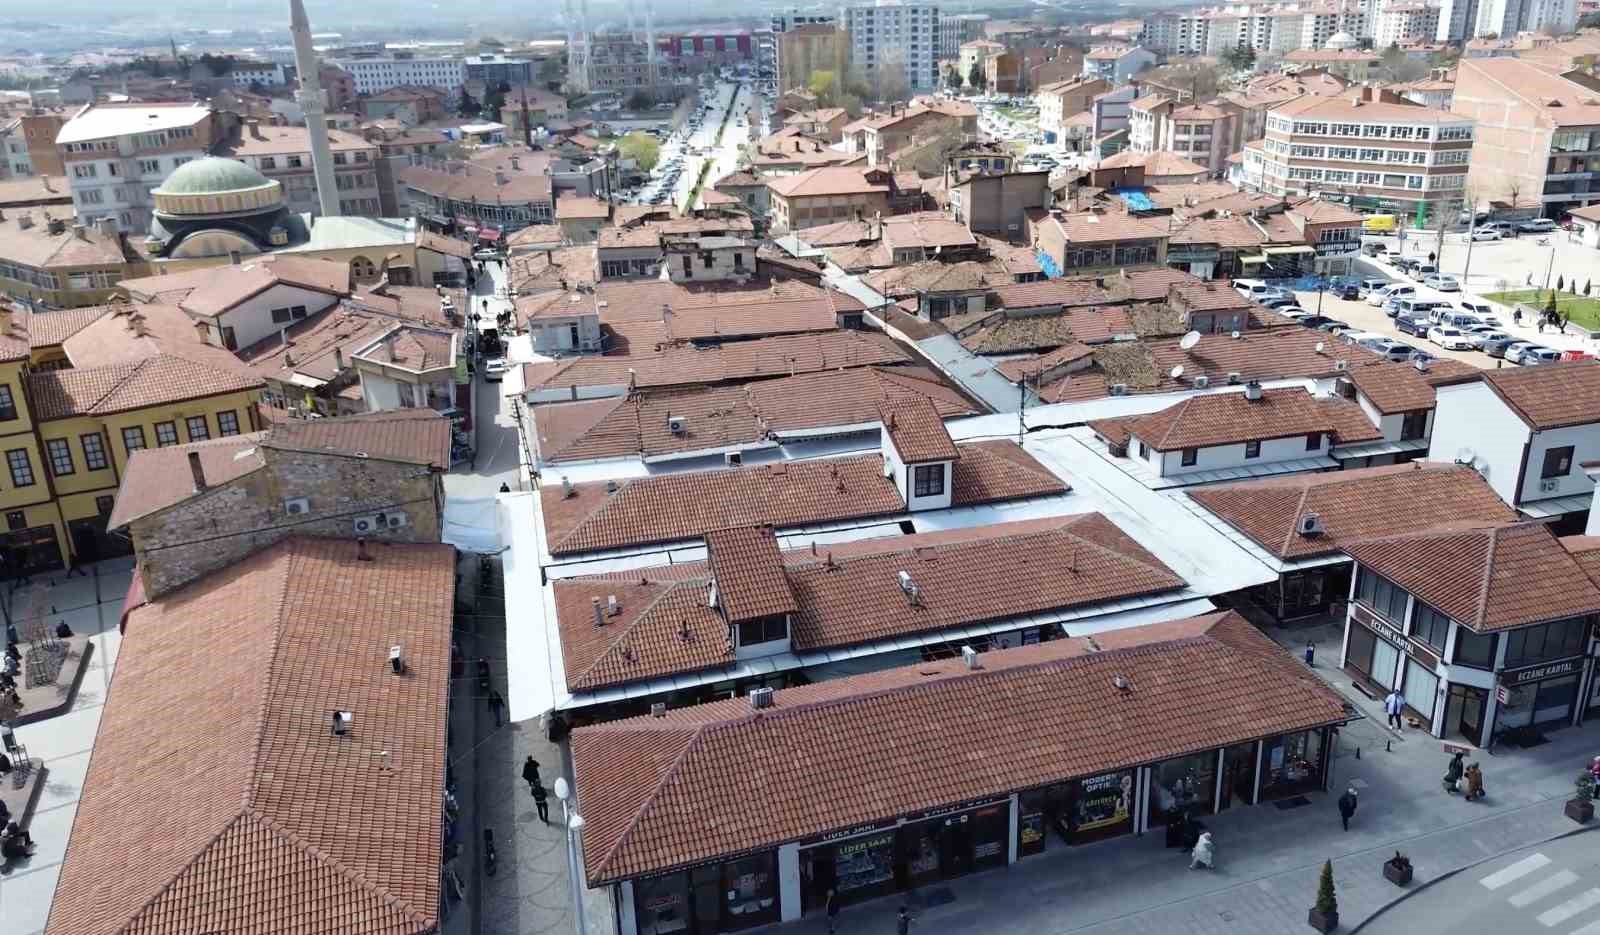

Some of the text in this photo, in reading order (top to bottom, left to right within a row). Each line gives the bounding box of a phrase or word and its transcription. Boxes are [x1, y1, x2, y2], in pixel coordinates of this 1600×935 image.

[1371, 619, 1414, 655] ECZANE KARTAL
[1518, 662, 1572, 681] ECZANE KARTAL
[1082, 773, 1117, 787] MODERN
